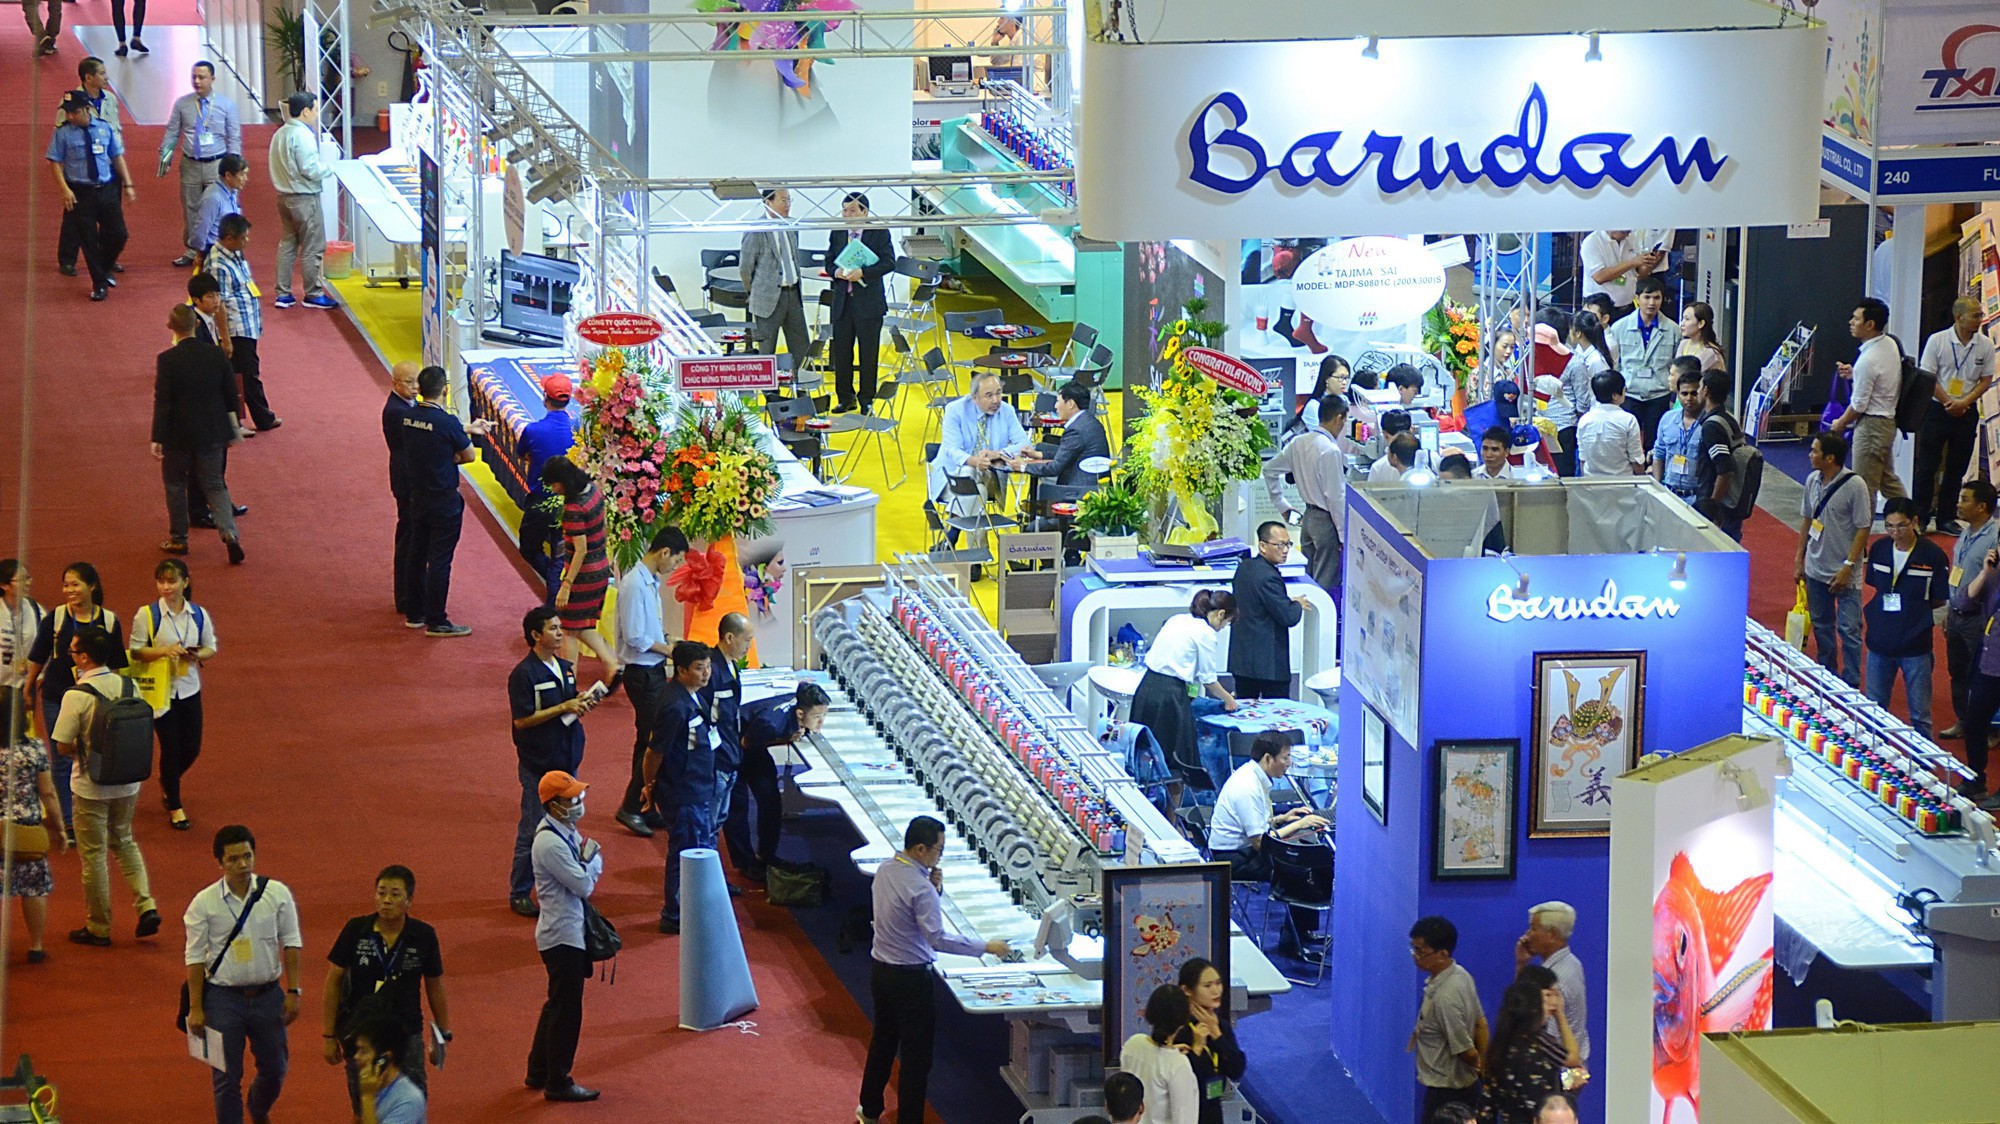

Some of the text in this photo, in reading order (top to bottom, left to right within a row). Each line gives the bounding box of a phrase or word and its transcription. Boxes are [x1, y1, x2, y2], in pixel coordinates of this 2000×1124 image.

[1188, 82, 1729, 194] Barudan
[1884, 171, 1910, 185] 240
[1336, 269, 1373, 278] TAJIMA
[1296, 282, 1332, 291] MODEL:
[690, 364, 710, 373] CÔNG
[719, 364, 736, 372] MING
[1188, 350, 1263, 392] CONGRATULATIONS
[684, 375, 700, 384] CHÚC
[750, 374, 772, 382] TAJIMA
[1009, 543, 1053, 553] Barudan
[1487, 578, 1681, 623] Barudan
